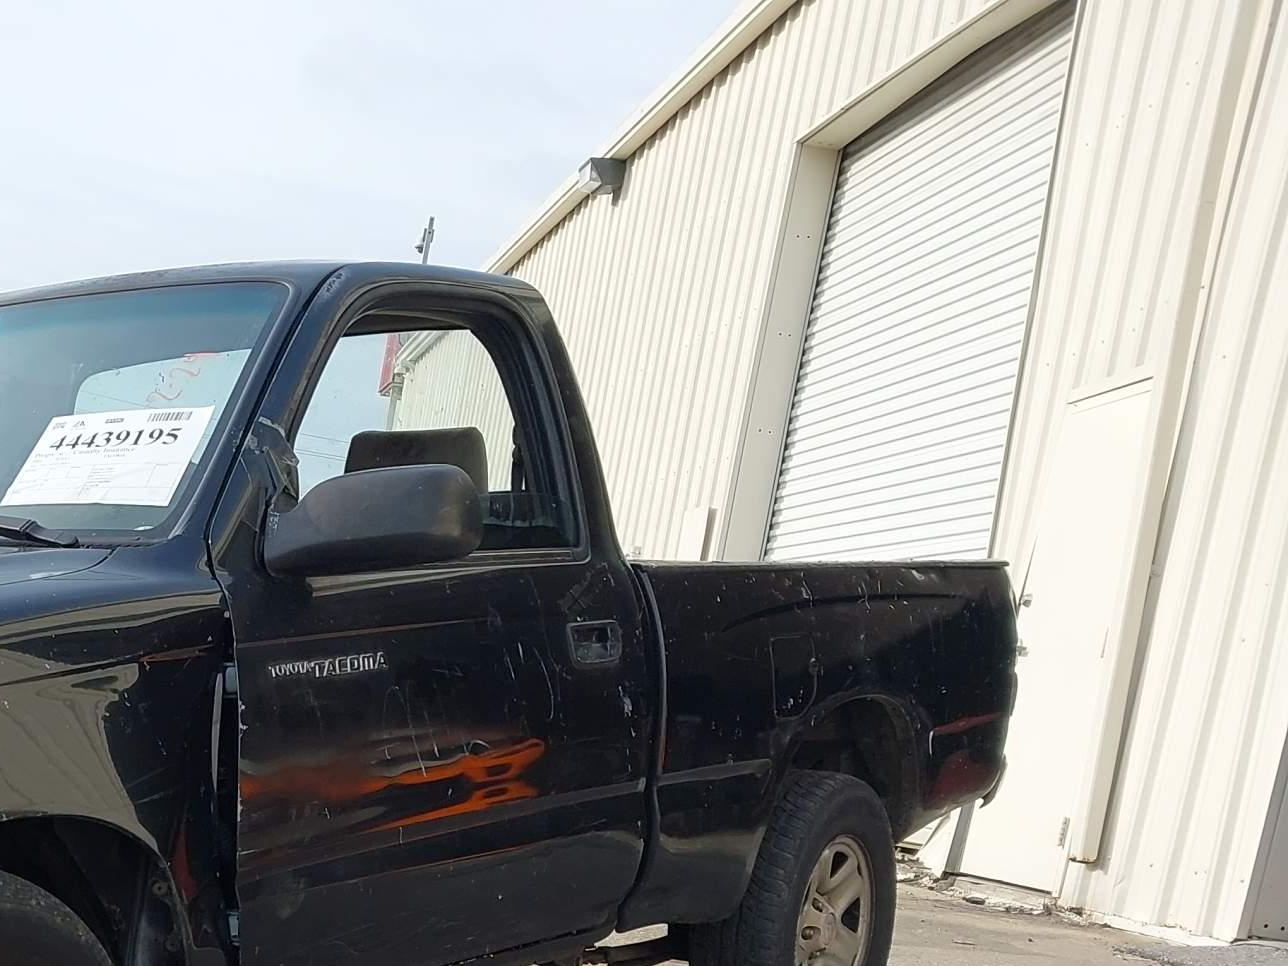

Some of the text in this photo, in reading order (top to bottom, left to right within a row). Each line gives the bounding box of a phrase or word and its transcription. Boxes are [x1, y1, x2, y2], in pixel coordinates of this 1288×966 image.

[50, 427, 183, 451] 44439195
[268, 651, 388, 678] TOYOTA TACOMA
